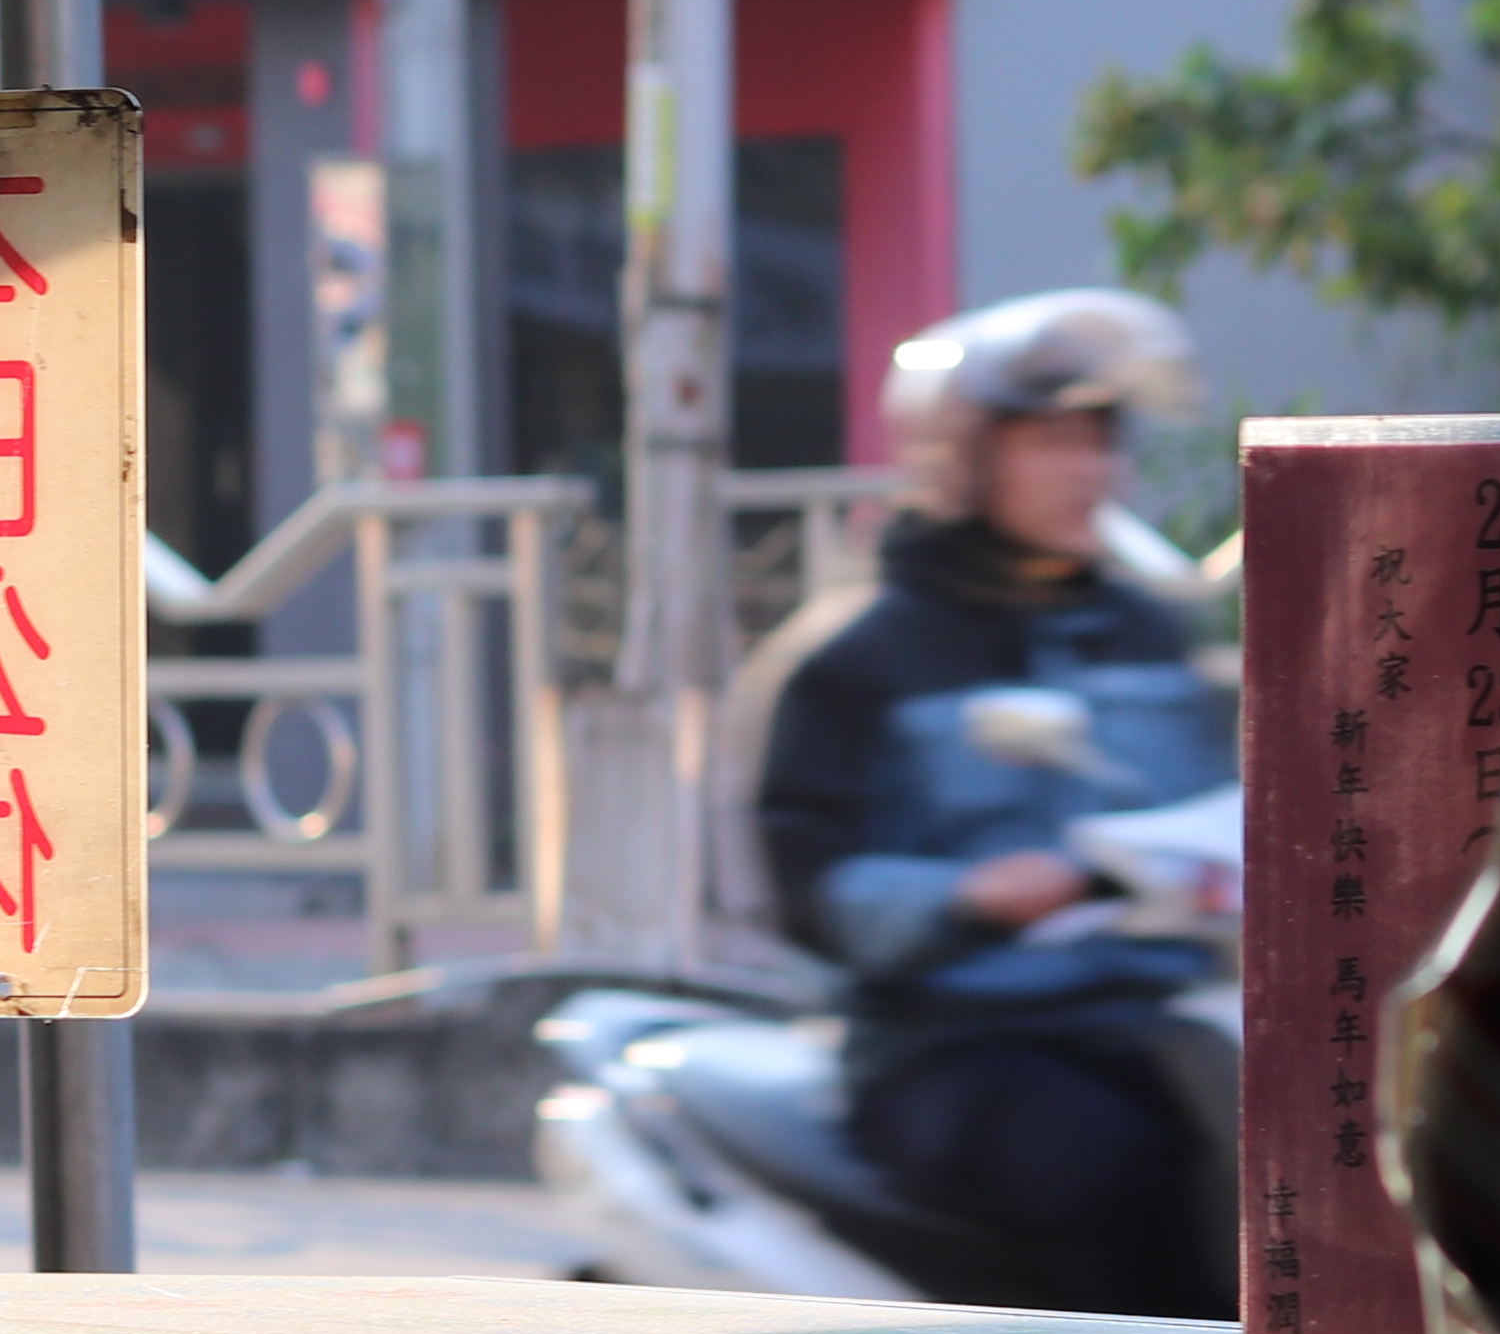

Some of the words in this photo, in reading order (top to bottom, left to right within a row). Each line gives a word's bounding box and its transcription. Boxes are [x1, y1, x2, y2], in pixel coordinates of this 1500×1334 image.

[1370, 546, 1414, 701] 祝大家
[1329, 707, 1370, 919] 新年快樂
[1329, 957, 1370, 1170] 馬年如意
